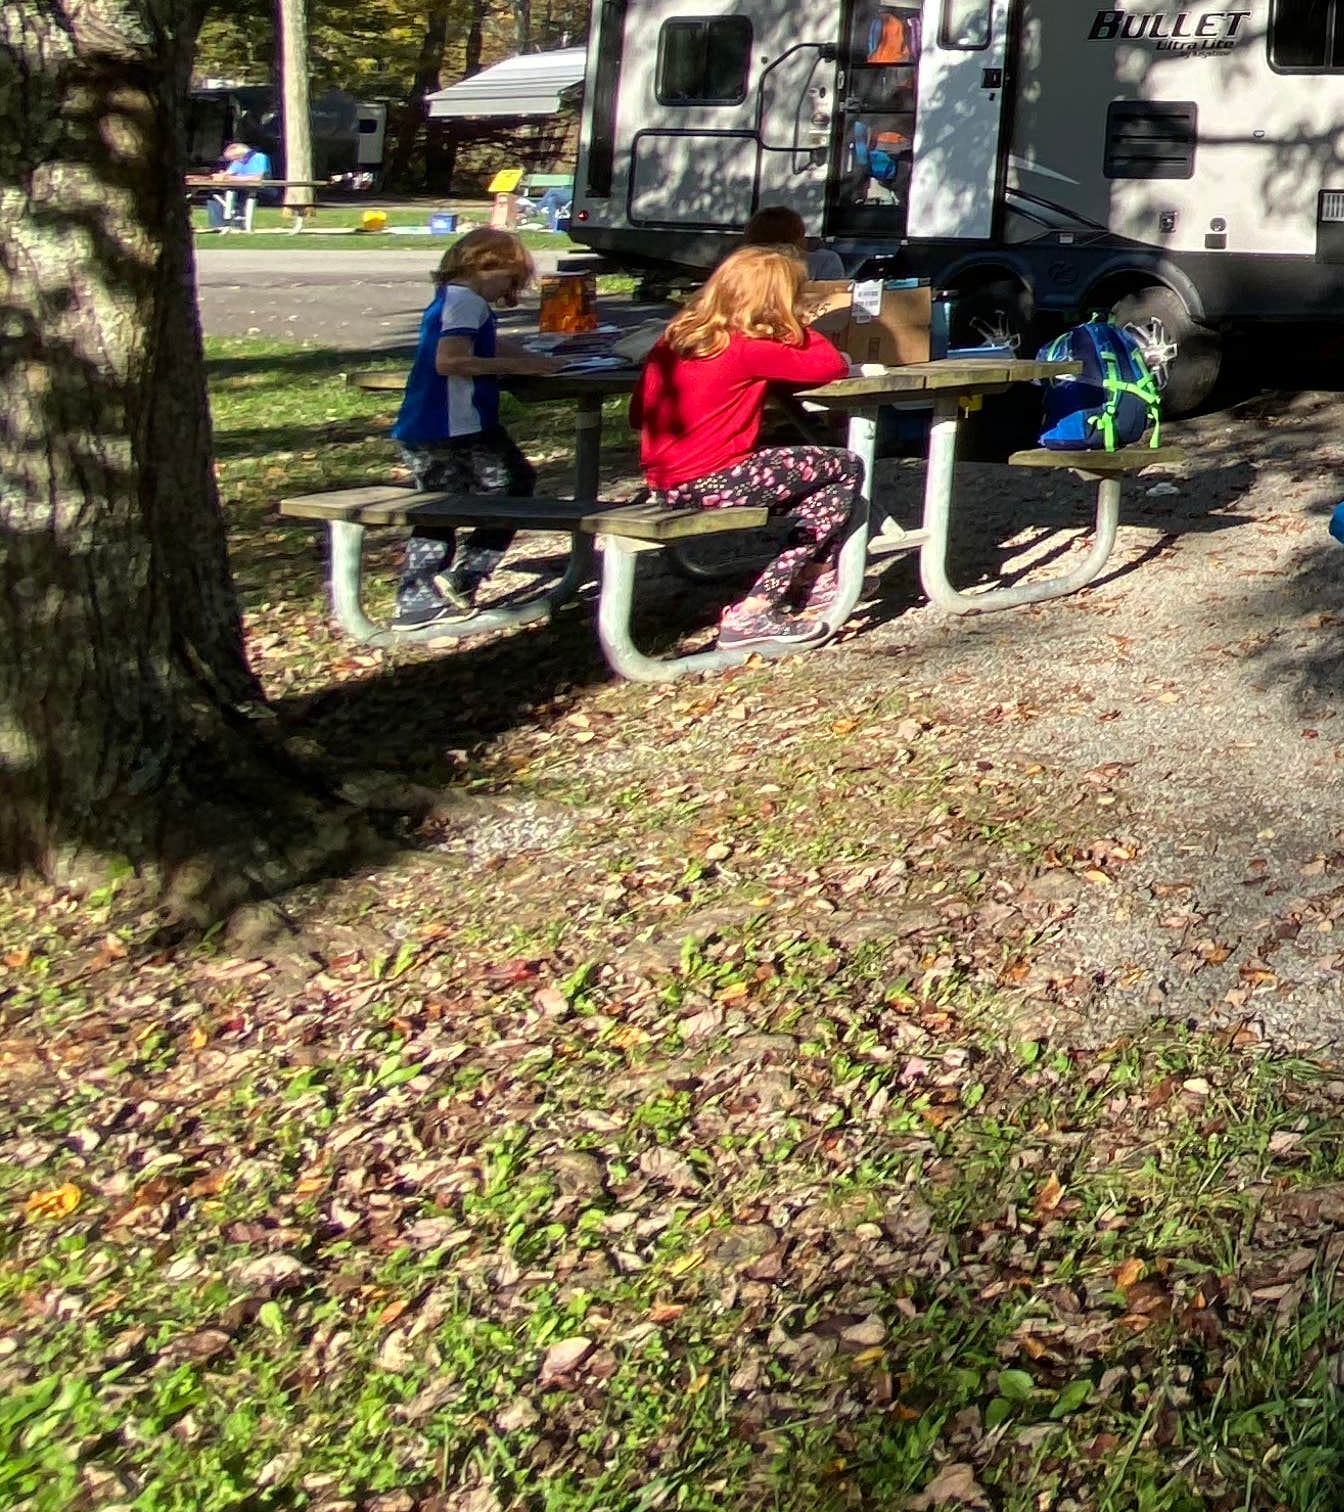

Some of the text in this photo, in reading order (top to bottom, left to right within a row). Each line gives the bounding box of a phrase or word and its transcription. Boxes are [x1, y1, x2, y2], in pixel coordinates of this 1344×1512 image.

[1088, 10, 1251, 40] BULLET
[1156, 39, 1235, 50] Ultra Lite
